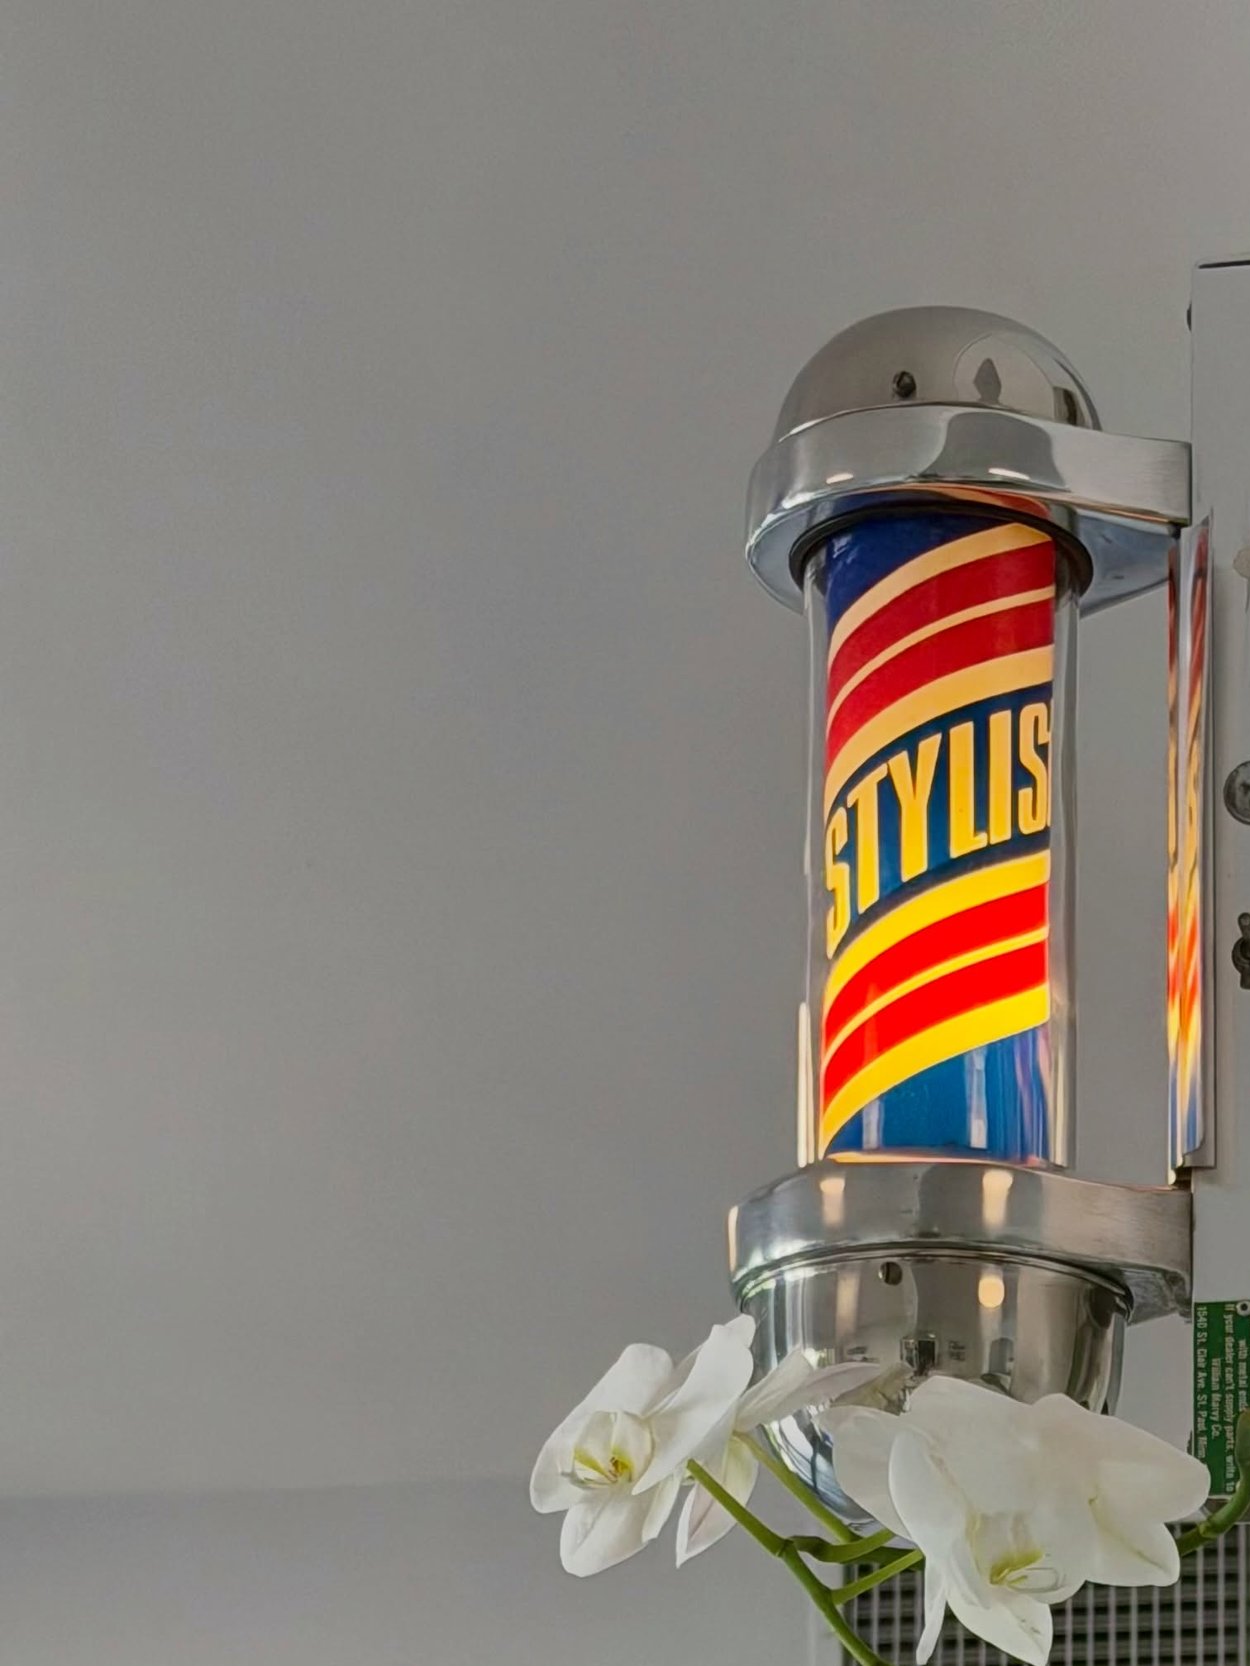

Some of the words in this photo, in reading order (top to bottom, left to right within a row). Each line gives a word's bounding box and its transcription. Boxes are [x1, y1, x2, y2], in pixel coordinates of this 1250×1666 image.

[826, 702, 1051, 960] STYLIS
[1197, 1306, 1207, 1328] 1540
[1224, 1303, 1235, 1311] If
[1223, 1314, 1233, 1333] your
[1197, 1331, 1207, 1345] St.
[1238, 1338, 1248, 1359] with
[1197, 1348, 1207, 1368] Clair
[1224, 1336, 1235, 1364] dealer
[1211, 1358, 1221, 1391] William
[1224, 1367, 1235, 1391] can't
[1238, 1361, 1248, 1388] metal
[1196, 1394, 1207, 1408] St.
[1210, 1393, 1221, 1422] Marvy
[1223, 1393, 1235, 1423] supply
[1211, 1424, 1221, 1439] Co.
[1225, 1455, 1235, 1479] write
[1226, 1482, 1235, 1492] to
